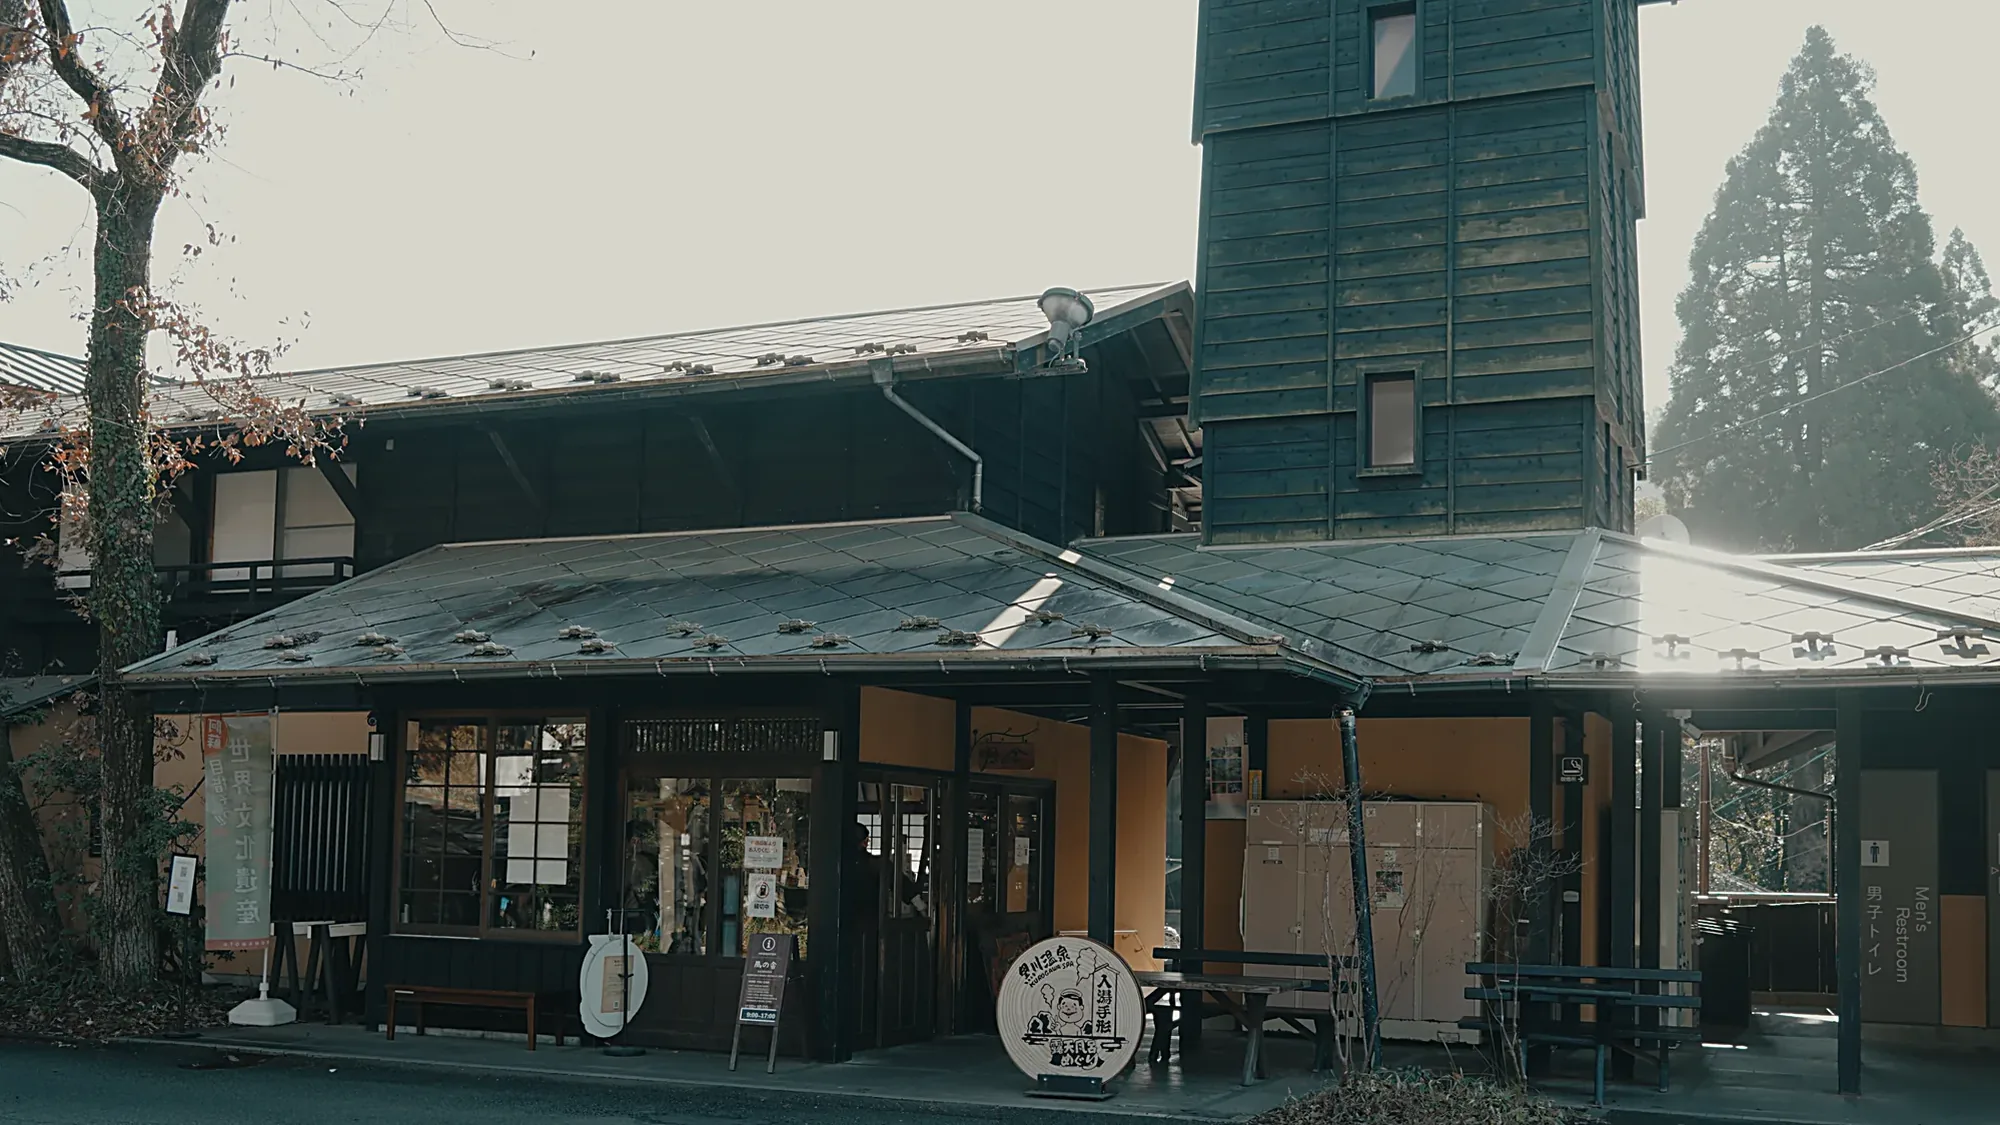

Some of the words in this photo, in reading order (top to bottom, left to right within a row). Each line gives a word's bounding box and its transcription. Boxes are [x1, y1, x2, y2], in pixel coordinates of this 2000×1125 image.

[1866, 886, 1883, 975] 男子トイレ
[1915, 887, 1931, 932] Men's
[1019, 945, 1070, 985] 黒川温泉
[1896, 907, 1910, 983] Restroom
[1029, 964, 1062, 988] KUROGAWA
[1062, 961, 1075, 970] SPA
[1096, 974, 1112, 1034] 入湯手形
[1050, 1038, 1098, 1054] 露天風呂
[1060, 1053, 1099, 1070] めぐり
